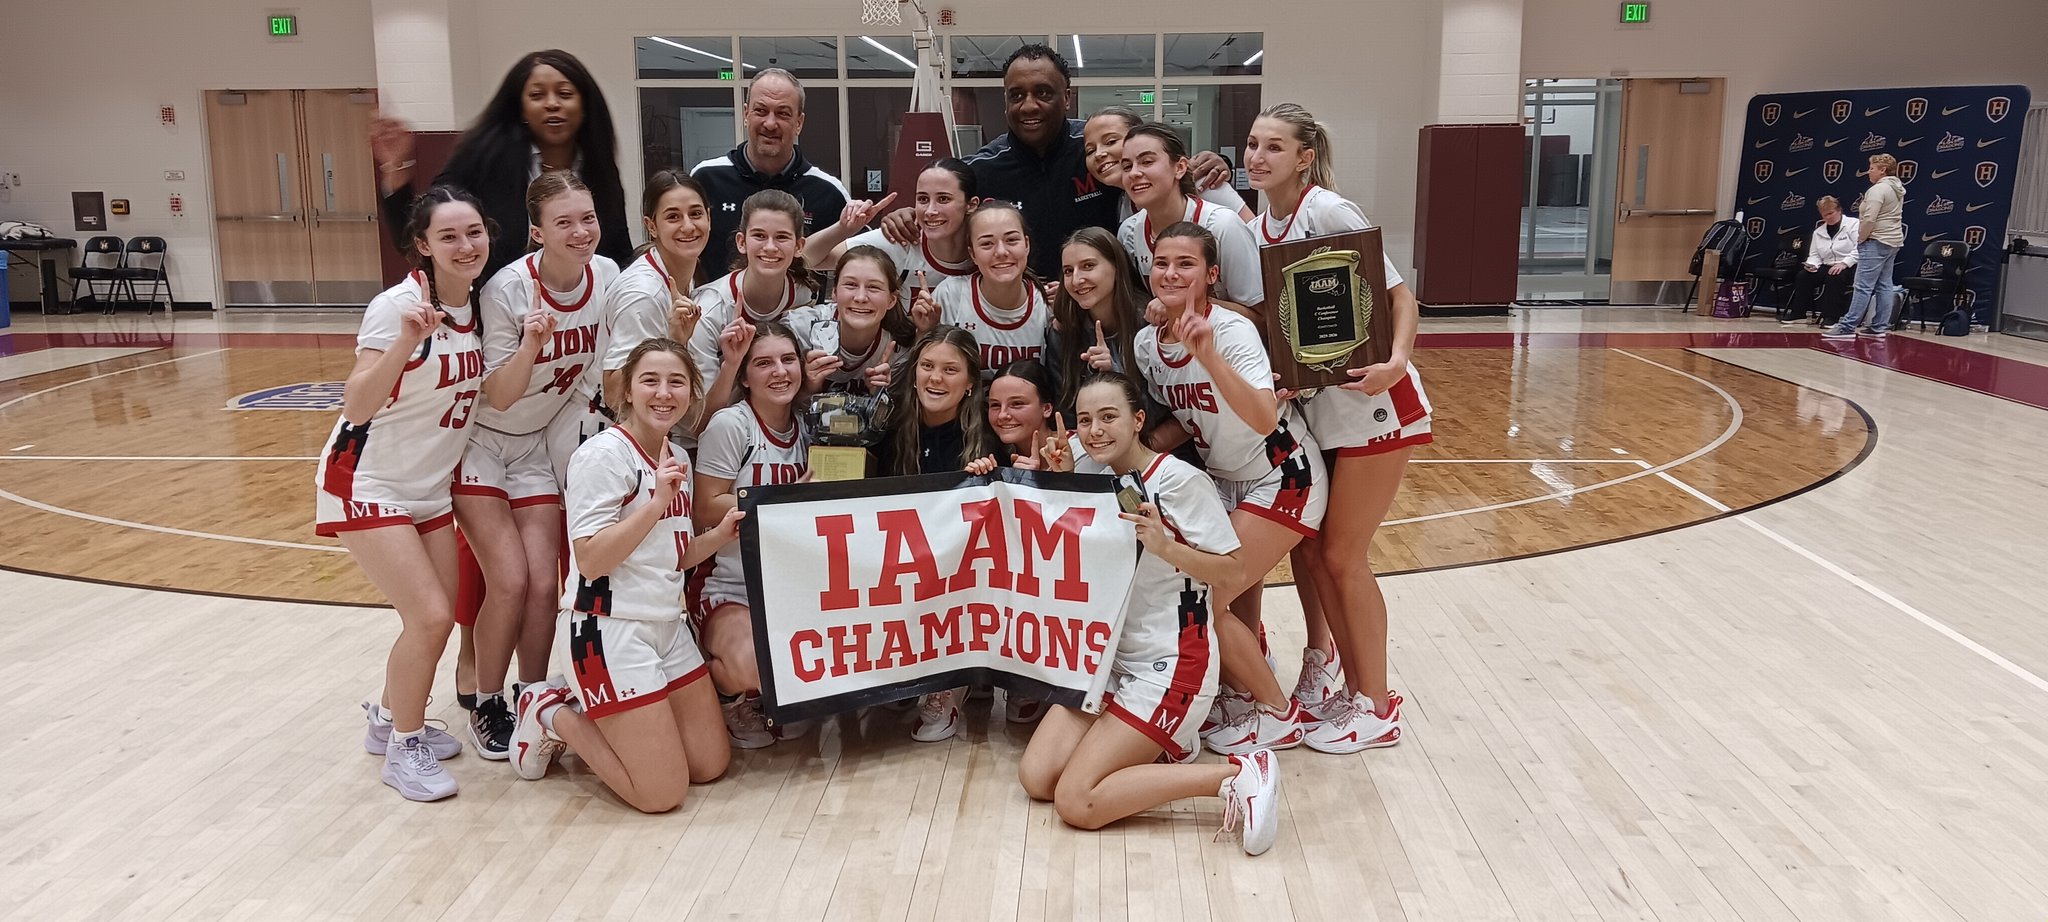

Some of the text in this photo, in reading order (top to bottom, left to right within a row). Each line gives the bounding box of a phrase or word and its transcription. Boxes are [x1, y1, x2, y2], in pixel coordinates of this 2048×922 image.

[1626, 5, 1648, 20] EXIT
[272, 18, 291, 34] EXIT
[1765, 107, 1777, 120] H
[1835, 104, 1847, 118] H
[1910, 102, 1924, 116] H
[1990, 101, 2006, 116] H
[1758, 164, 1769, 177] H
[1827, 164, 1839, 177] H
[1900, 164, 1912, 179] H
[1980, 166, 1994, 181] H
[1968, 230, 1982, 245] H
[1310, 279, 1337, 289] IAAM
[534, 322, 599, 365] LION
[542, 363, 584, 395] 14
[439, 390, 478, 429] 13
[349, 501, 373, 519] M
[815, 497, 1096, 612] IAAM
[789, 602, 1113, 683] CHAMPIONS
[585, 682, 612, 708] M
[1156, 709, 1179, 734] M
